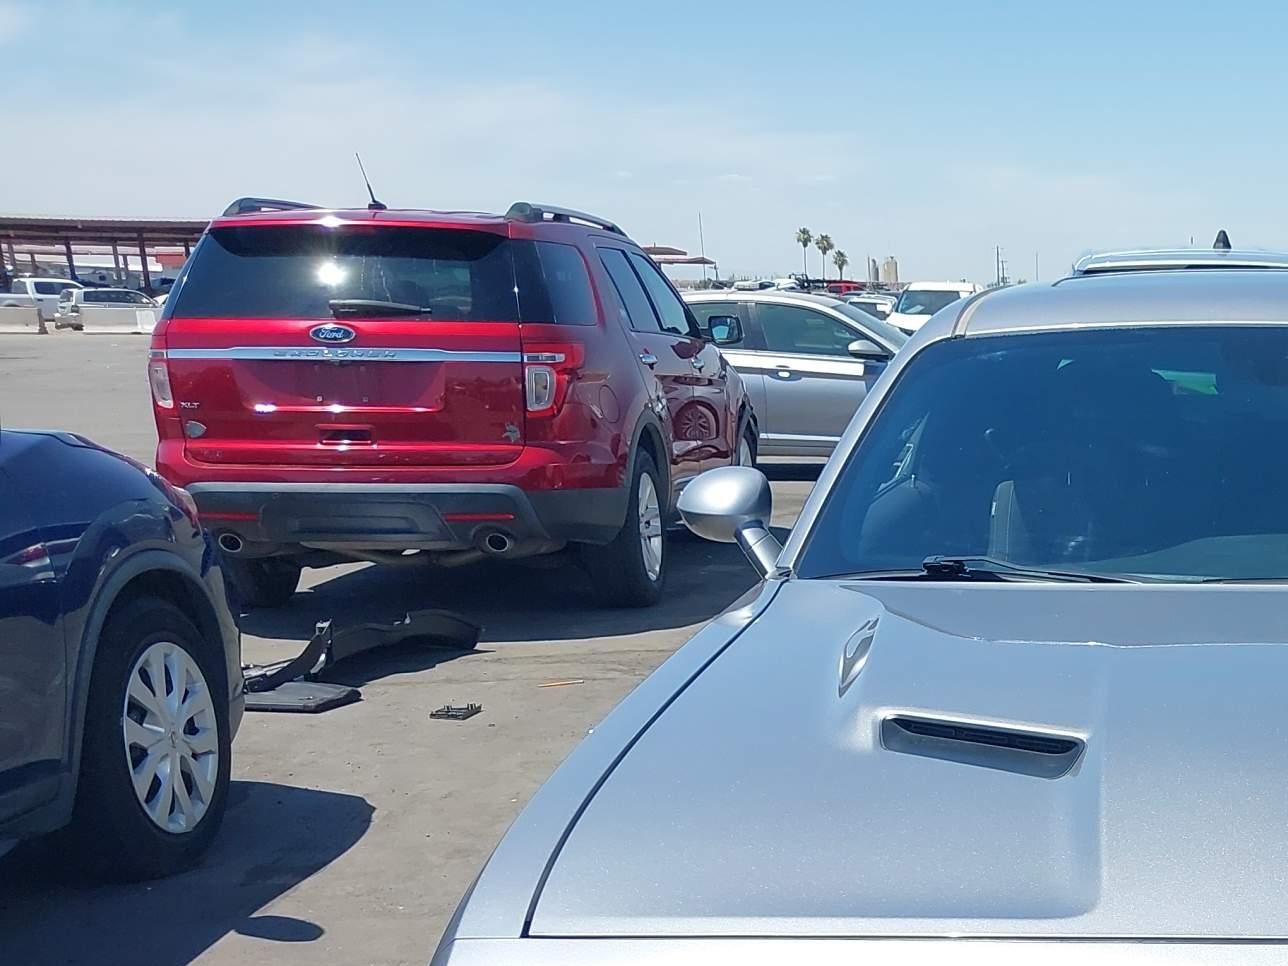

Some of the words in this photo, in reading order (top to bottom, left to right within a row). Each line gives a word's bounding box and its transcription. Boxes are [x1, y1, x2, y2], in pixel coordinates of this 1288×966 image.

[318, 328, 345, 340] Ford
[273, 349, 397, 358] EXPLORER
[180, 401, 200, 409] XLT
